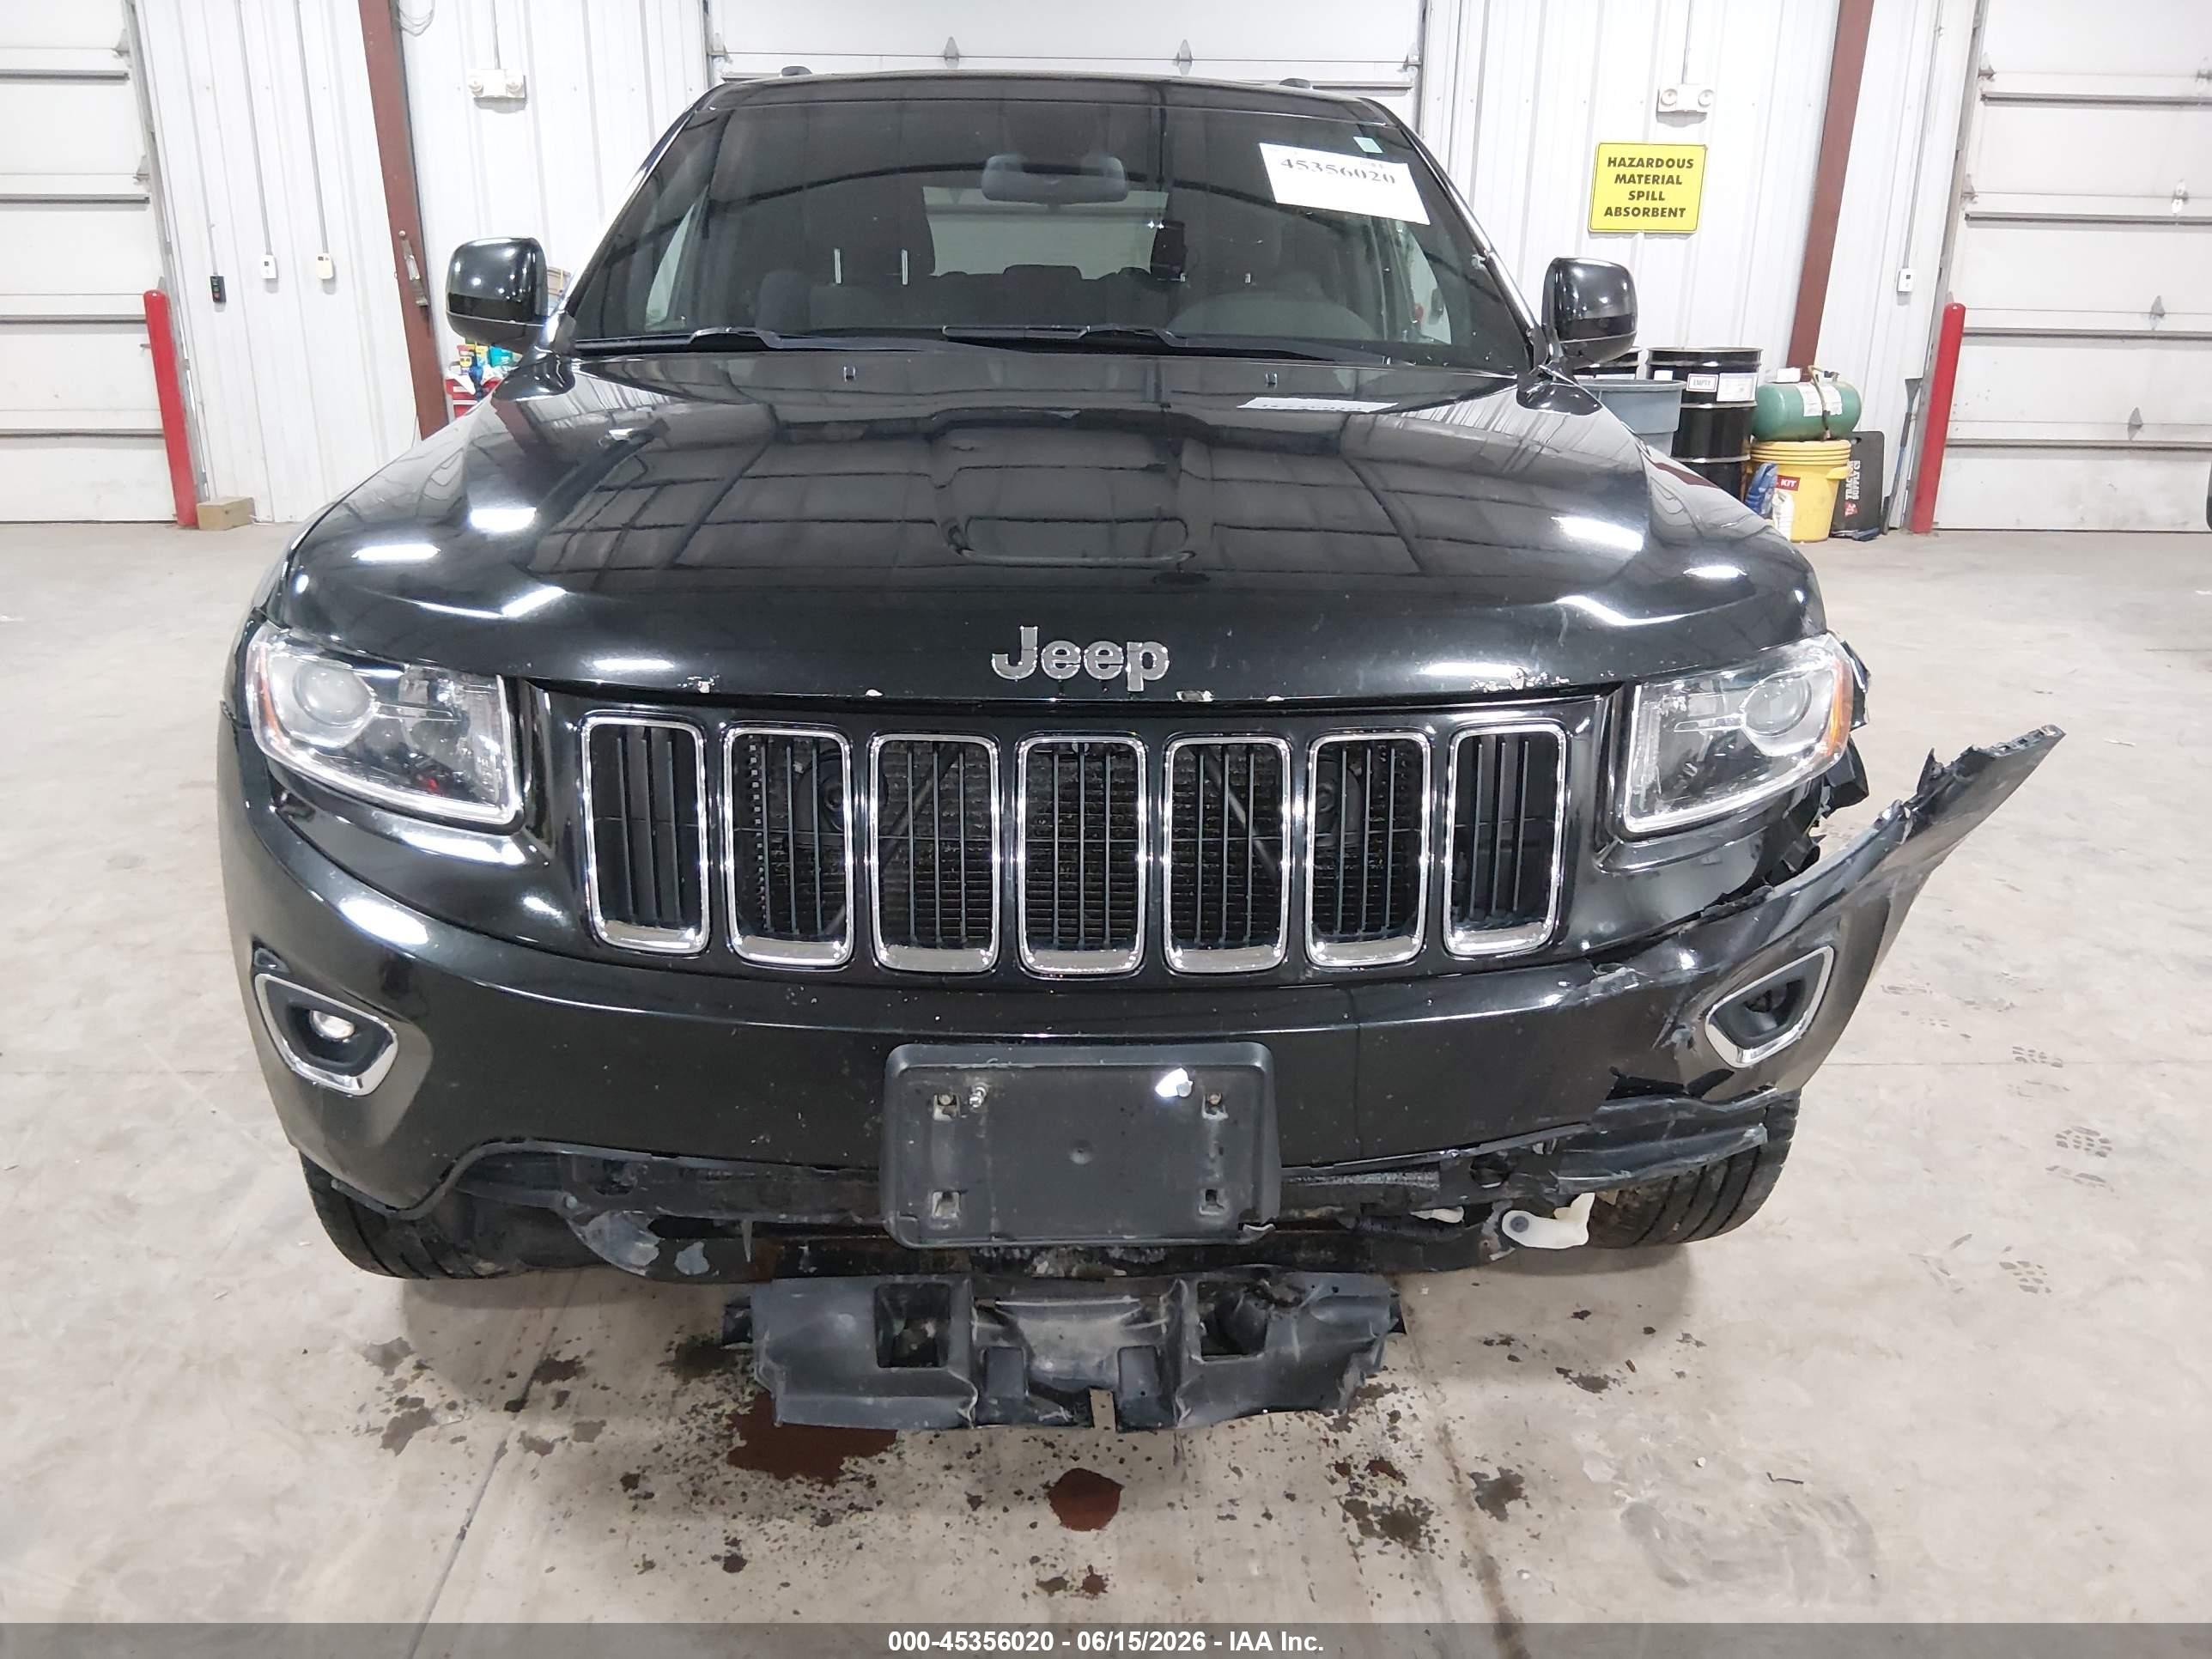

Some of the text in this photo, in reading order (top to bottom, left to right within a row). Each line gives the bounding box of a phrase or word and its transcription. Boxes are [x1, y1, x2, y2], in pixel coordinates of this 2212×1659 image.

[1607, 156, 1694, 169] HAZARDOUS
[1280, 158, 1396, 185] 45356020
[1614, 173, 1683, 185] MATERIAL
[1628, 190, 1666, 201] SPILL
[1604, 206, 1686, 218] ABSORBENT
[1692, 378, 1711, 386] EMPTY
[1780, 478, 1797, 488] KIT
[991, 626, 1170, 692] Jeep
